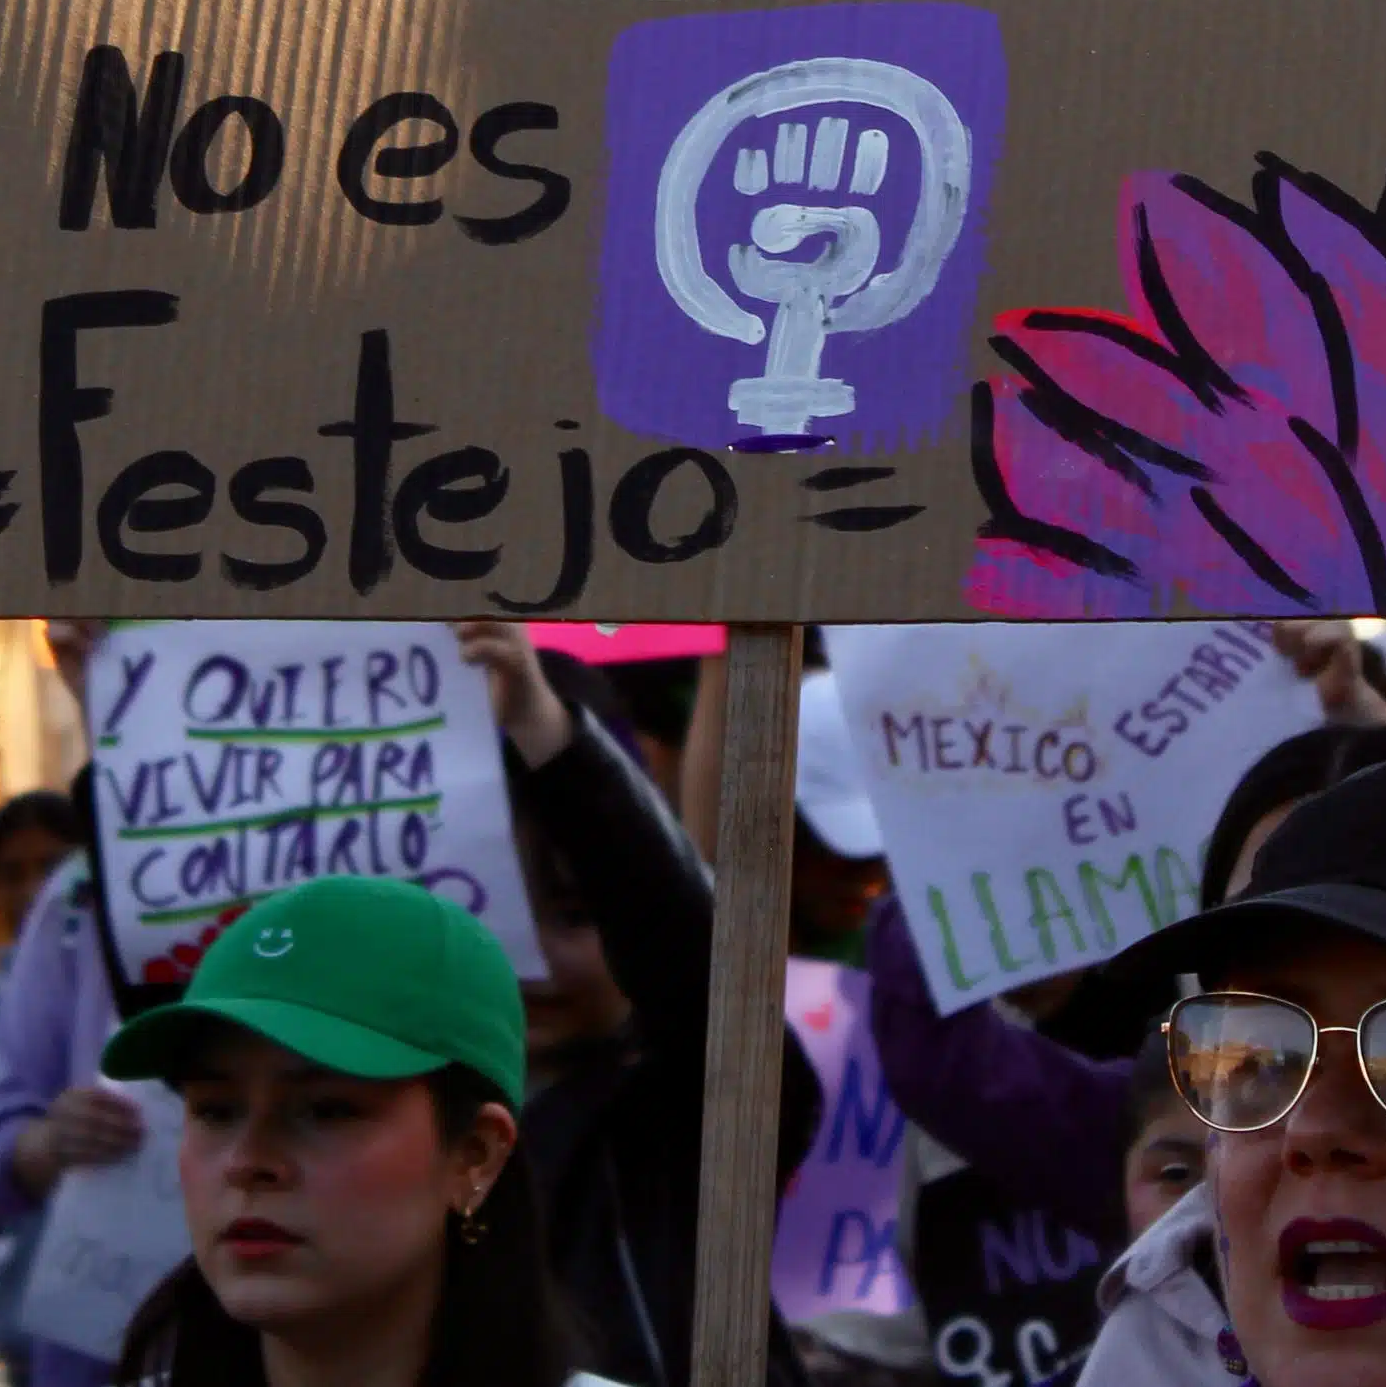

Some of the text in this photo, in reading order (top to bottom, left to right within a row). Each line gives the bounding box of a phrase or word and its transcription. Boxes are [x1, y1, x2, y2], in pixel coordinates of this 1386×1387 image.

[59, 44, 571, 244] No es
[100, 644, 441, 734] Y QUIERO
[99, 739, 435, 827] VIVIR PARA
[880, 711, 1099, 783] MEXICO
[129, 811, 431, 908] CONTARLO
[1062, 791, 1139, 846] EN
[925, 842, 1215, 992] LLAMA
